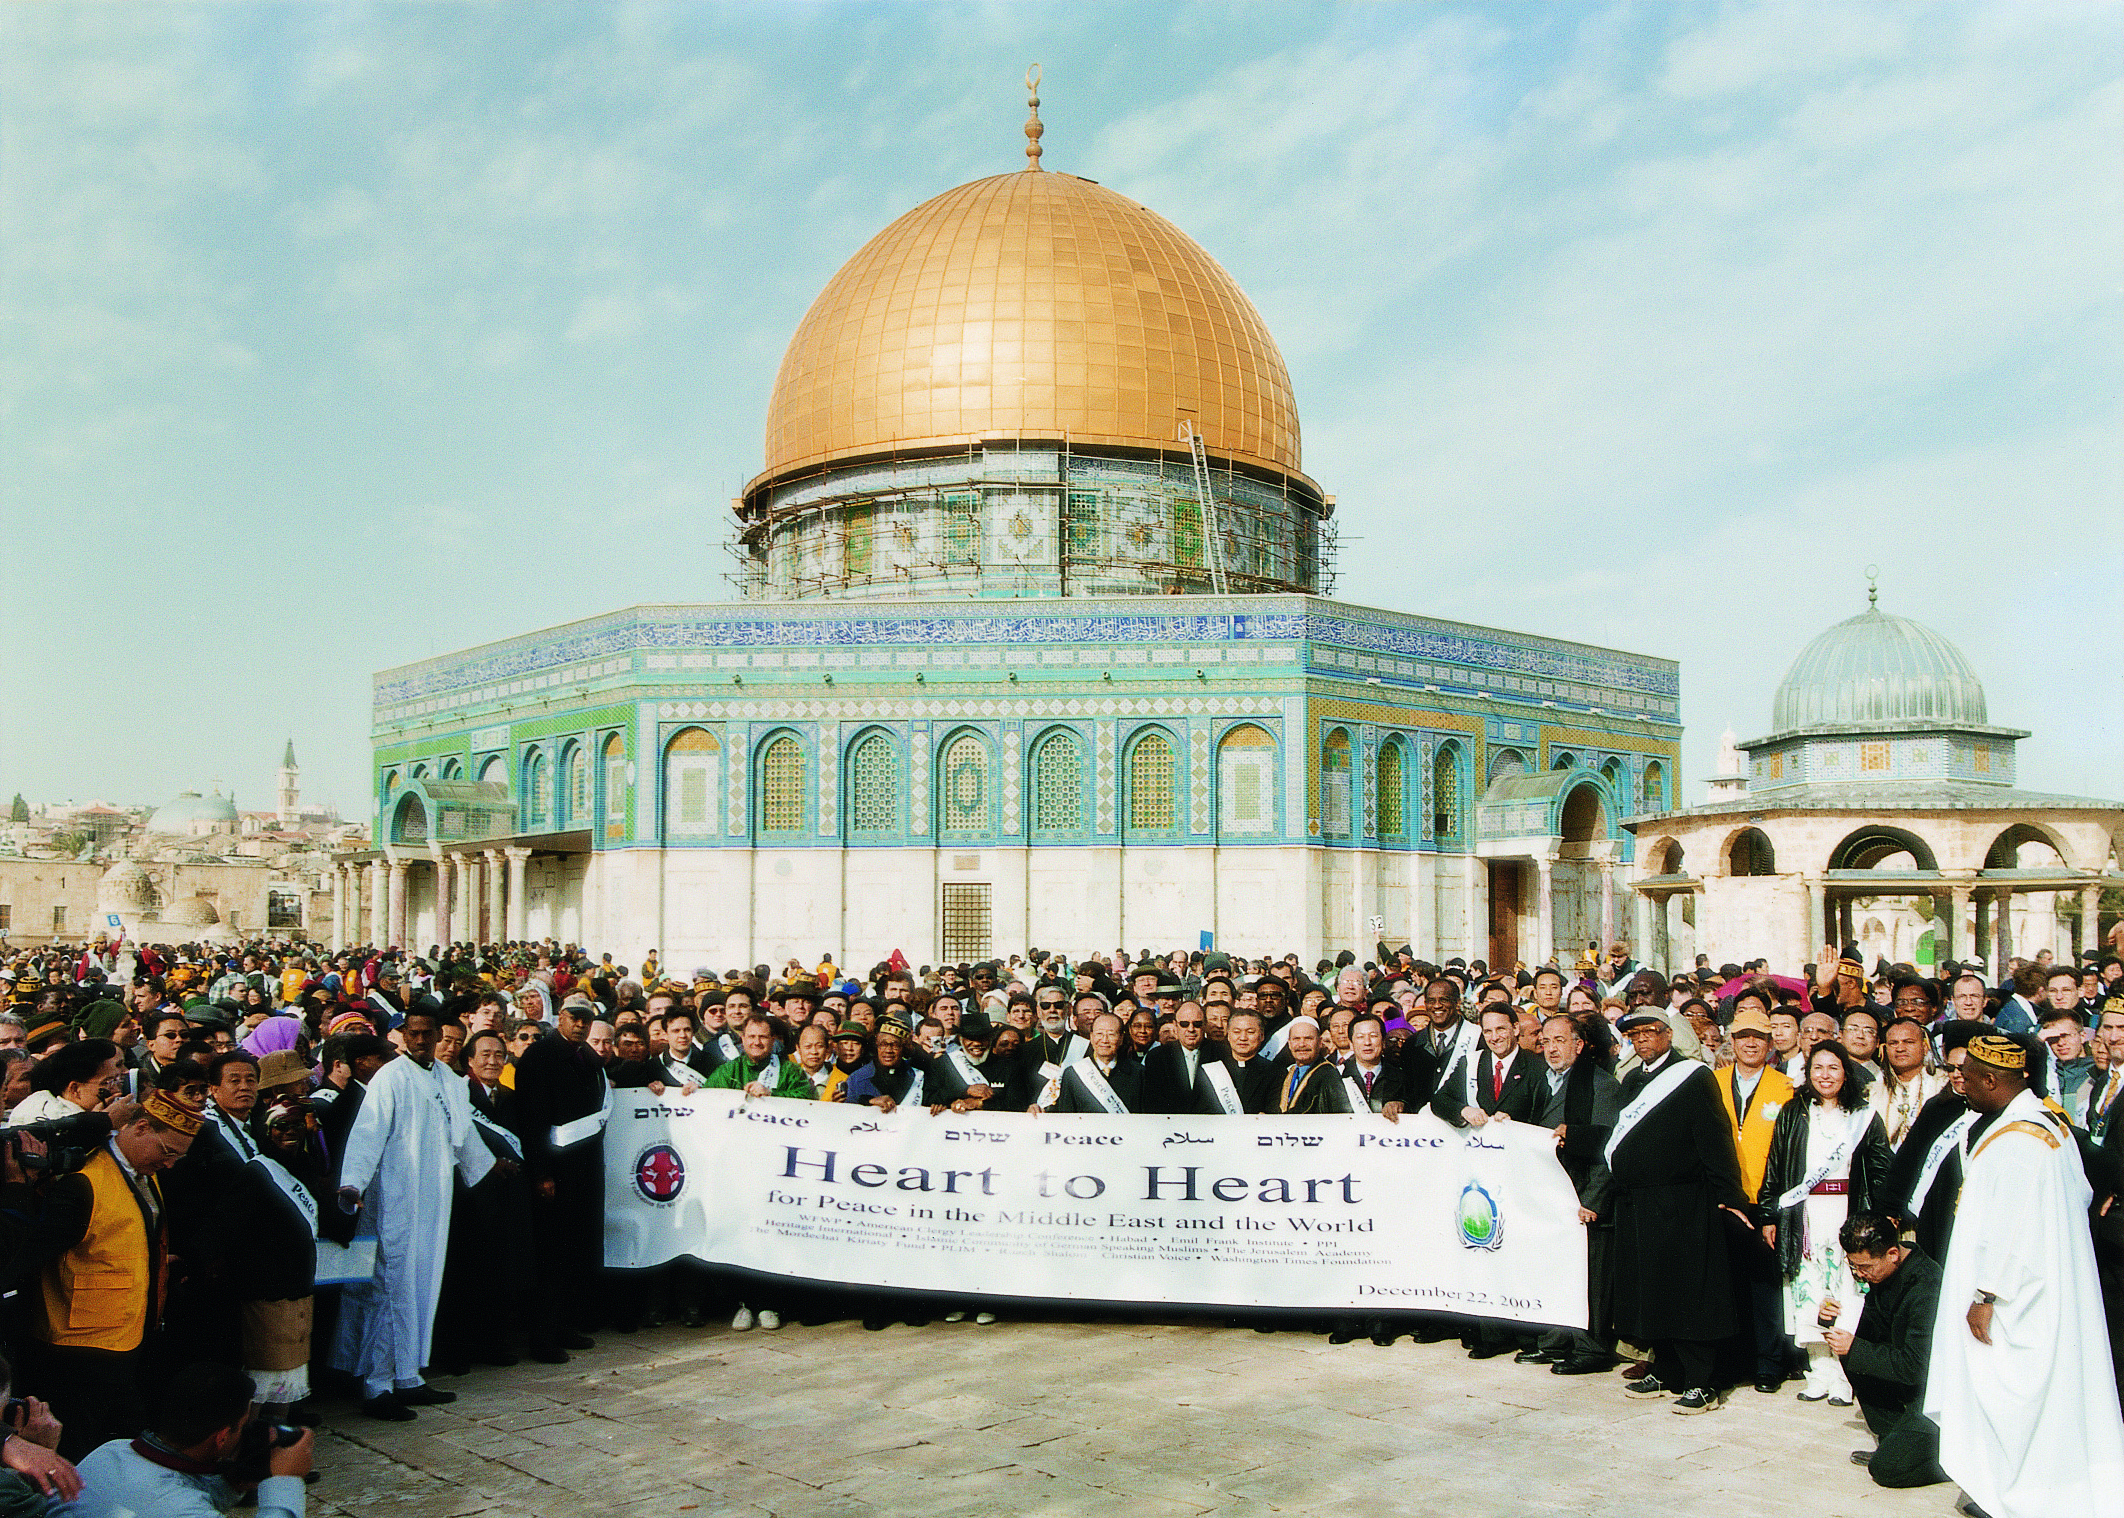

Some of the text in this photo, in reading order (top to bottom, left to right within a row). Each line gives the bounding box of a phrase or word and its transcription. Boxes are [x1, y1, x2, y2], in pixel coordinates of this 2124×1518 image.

[111, 916, 119, 925] 6
[1370, 916, 1383, 930] 32
[1220, 1086, 1236, 1114] Peace
[634, 1103, 695, 1120] שלום
[727, 1108, 810, 1128] Peace
[945, 1128, 1011, 1144] שלום
[1044, 1131, 1124, 1146] Peace
[1162, 1132, 1214, 1148] سلام
[1257, 1132, 1324, 1147] שלום
[1358, 1133, 1445, 1148] Peace
[777, 1144, 1363, 1204] Heart to Heart
[768, 1190, 1374, 1233] for Peace in the Middle East and the World
[765, 1219, 815, 1231] Heritage
[818, 1225, 893, 1239] International
[915, 1234, 958, 1244] Islamic
[1050, 1242, 1097, 1250] German
[1101, 1243, 1154, 1253] Speaking
[1158, 1245, 1209, 1253] Muslims
[1226, 1246, 1247, 1254] The
[1250, 1248, 1308, 1256] Jerusalem
[1315, 1250, 1373, 1258] Academy
[856, 1221, 914, 1233] American
[917, 1226, 956, 1237] Clergy
[1028, 1232, 1095, 1242] Conference
[1110, 1235, 1148, 1243] Habad
[776, 1228, 840, 1242] Mordechai
[896, 1241, 926, 1250] Fund
[941, 1244, 975, 1253] PLIM
[1159, 1253, 1191, 1261] Voice
[1211, 1255, 1279, 1264] Washington
[1285, 1257, 1318, 1265] Times
[1358, 1284, 1462, 1300] December
[1500, 1295, 1543, 1310] 2003
